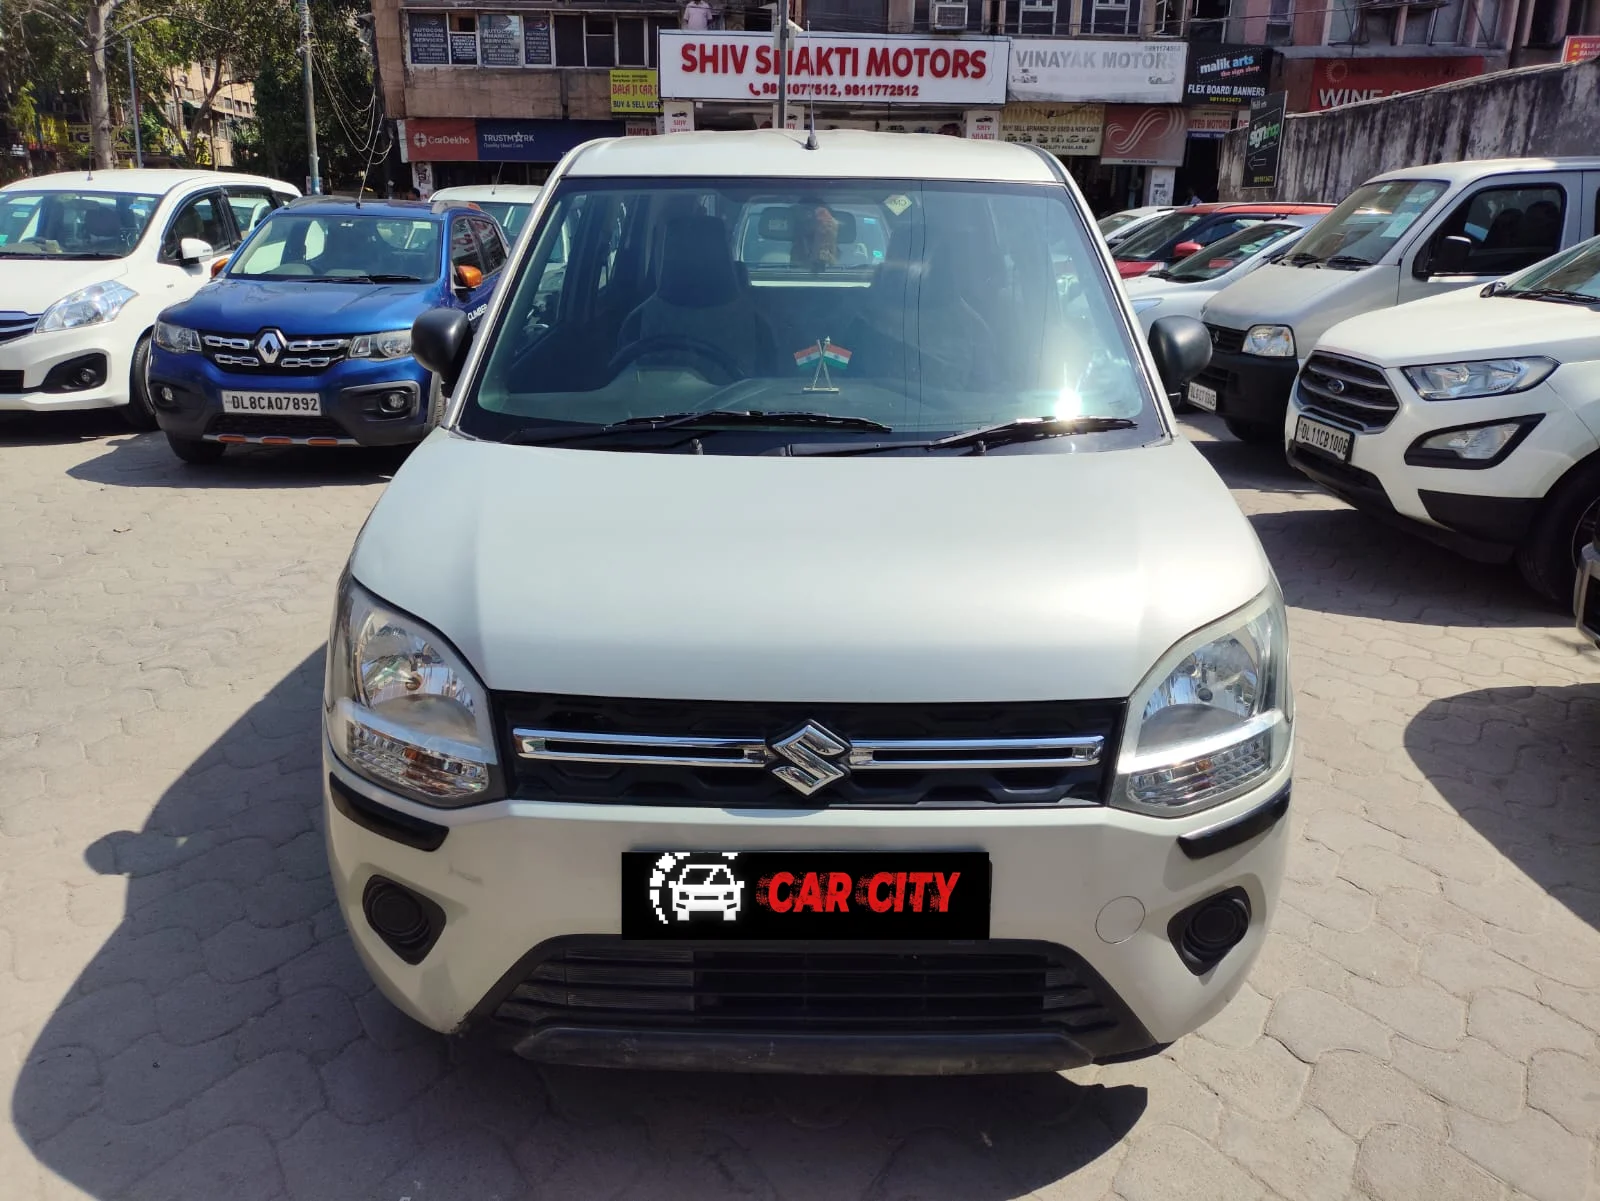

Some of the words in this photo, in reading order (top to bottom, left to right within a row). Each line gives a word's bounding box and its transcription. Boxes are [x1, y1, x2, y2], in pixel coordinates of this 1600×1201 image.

[681, 43, 749, 74] SHIV
[866, 47, 987, 79] MOTORS
[1016, 50, 1097, 69] VINAYAK
[1102, 50, 1179, 70] MOTORS
[1200, 57, 1230, 74] malik
[1232, 54, 1255, 68] arts
[612, 84, 631, 96] BALA
[762, 83, 842, 98] 981077512,
[1187, 84, 1206, 94] FLEX
[1233, 86, 1266, 97] BANNERS
[613, 100, 624, 108] BUY
[632, 101, 646, 109] SELL
[428, 135, 470, 145] CarDekho
[231, 395, 319, 411] DL8CAQ7892
